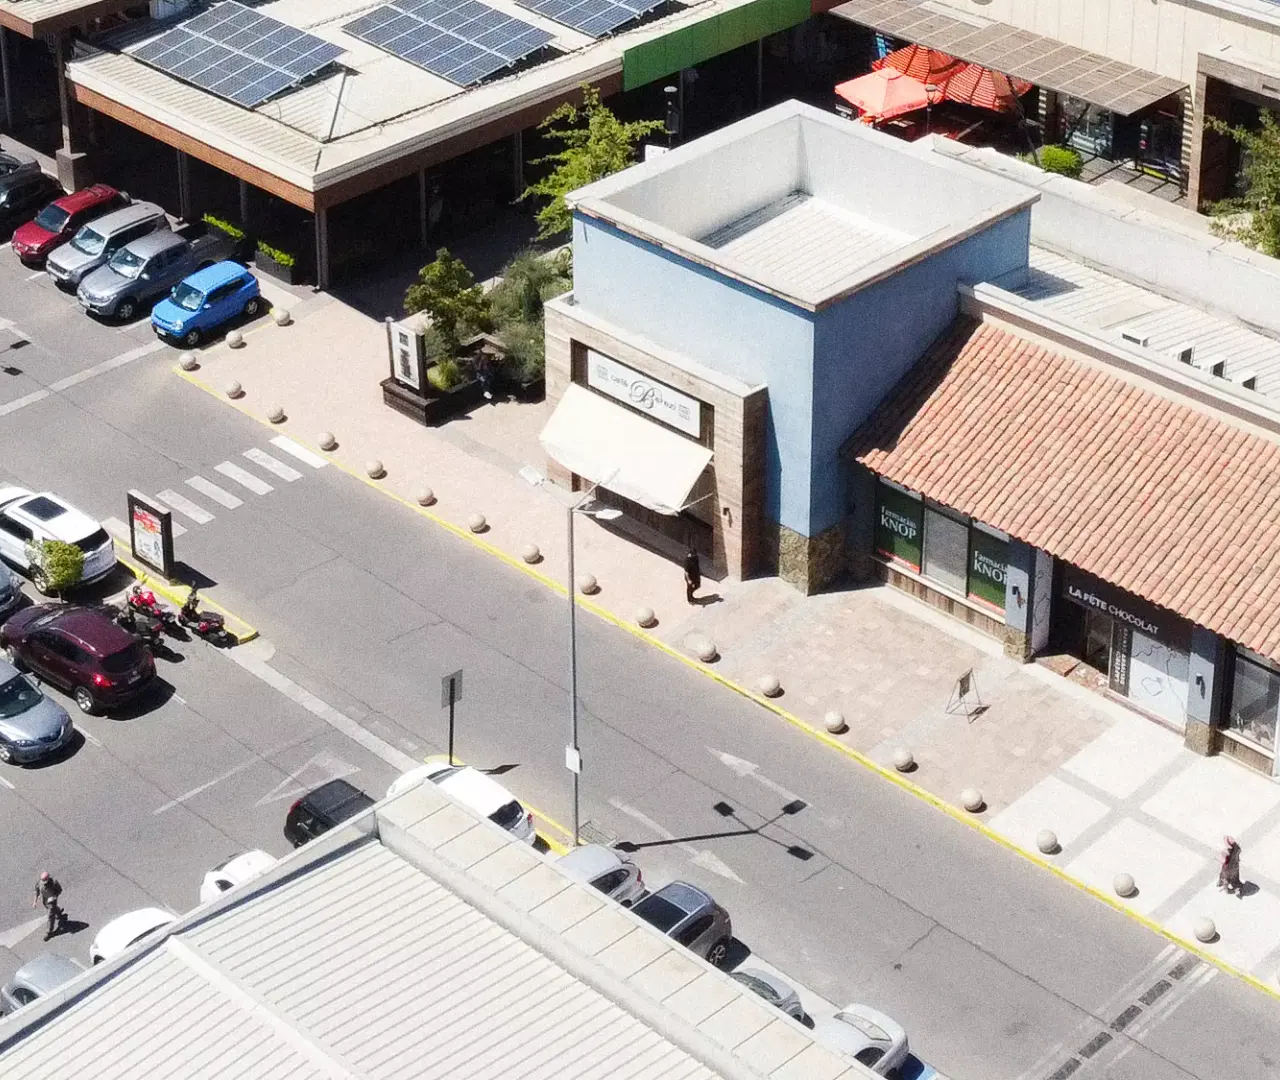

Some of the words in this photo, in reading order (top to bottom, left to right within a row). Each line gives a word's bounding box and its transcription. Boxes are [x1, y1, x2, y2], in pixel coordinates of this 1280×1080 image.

[881, 505, 917, 529] Farmacias
[881, 514, 917, 539] KNOP
[1068, 585, 1082, 599] LA
[1108, 604, 1159, 634] CHOCOLAT
